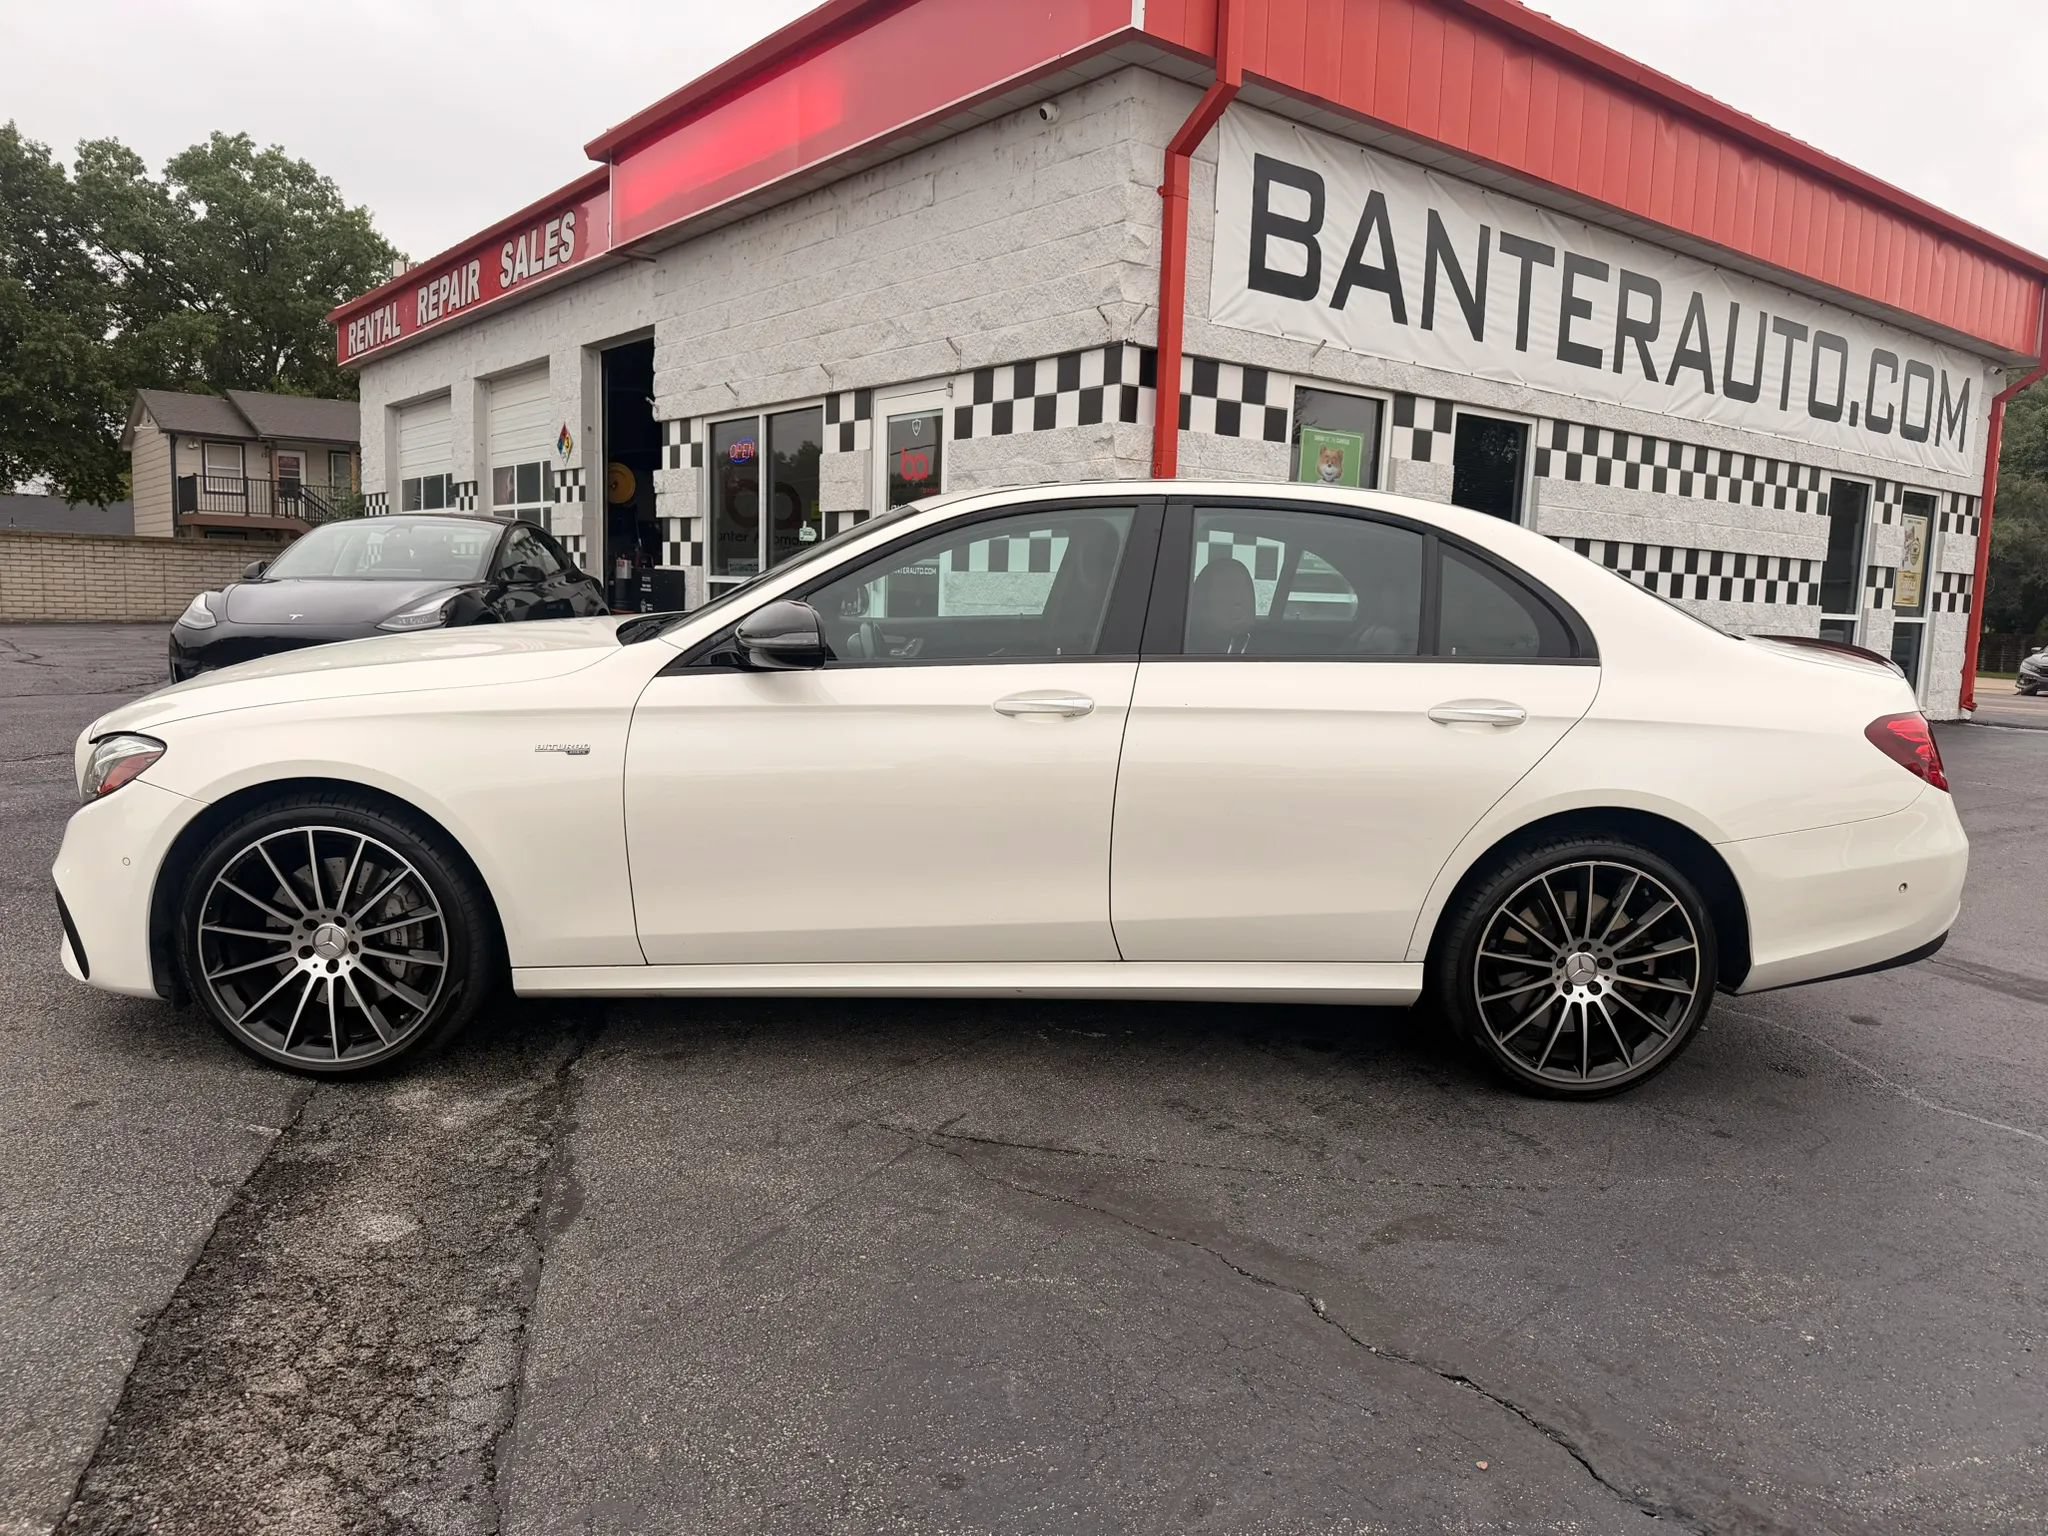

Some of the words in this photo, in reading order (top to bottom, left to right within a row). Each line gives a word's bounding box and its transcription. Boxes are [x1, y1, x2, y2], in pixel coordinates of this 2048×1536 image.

[348, 302, 401, 355] RENTAL
[416, 259, 481, 326] REPAIR
[500, 211, 577, 289] SALES
[1248, 153, 1972, 454] BANTERAUTO.COM
[729, 442, 755, 459] OPEN
